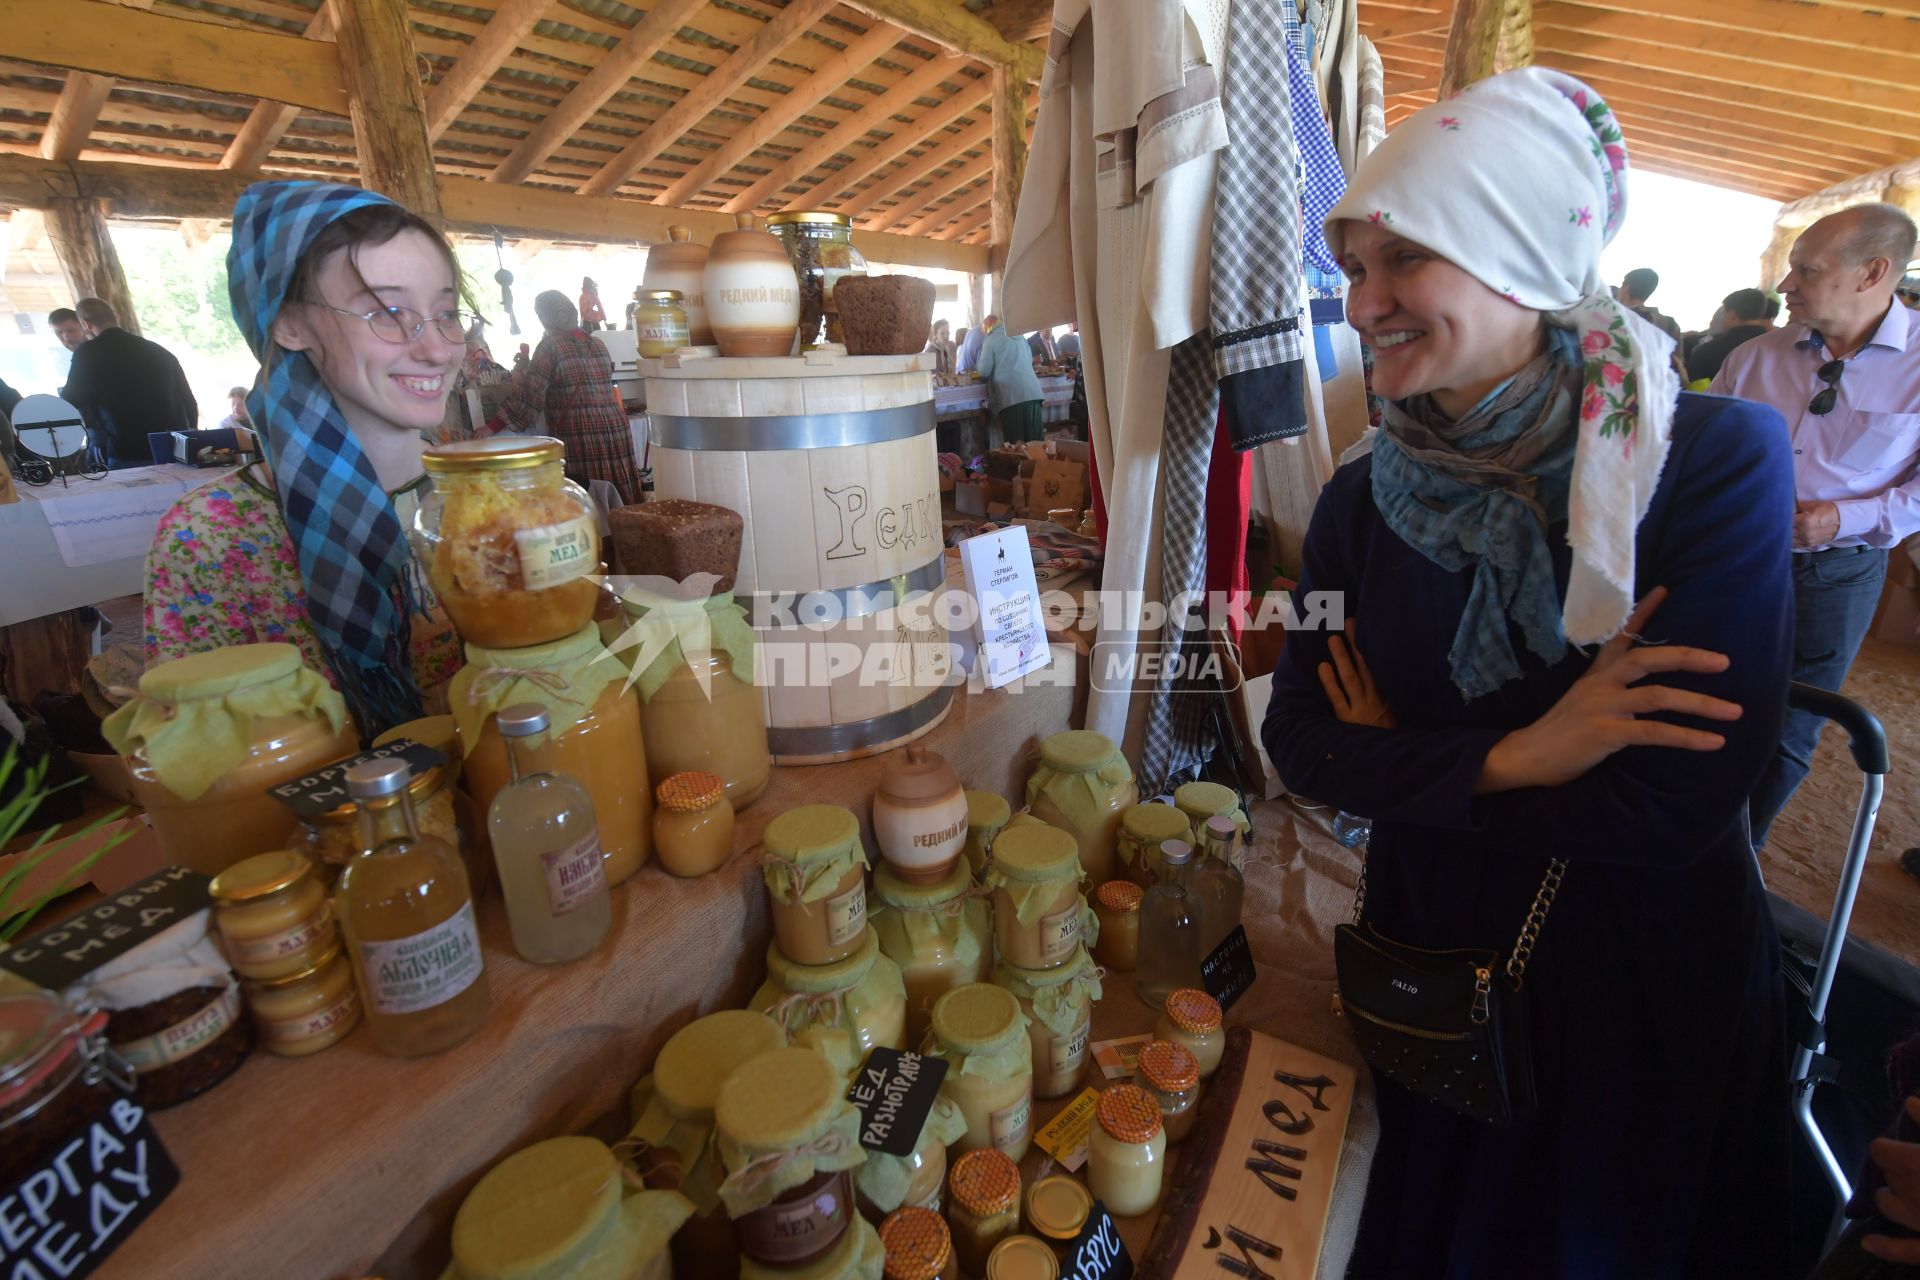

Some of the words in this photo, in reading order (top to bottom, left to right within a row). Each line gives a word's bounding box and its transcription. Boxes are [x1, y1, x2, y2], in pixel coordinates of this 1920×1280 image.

[720, 286, 767, 305] РЕДКИЙ
[994, 565, 1013, 577] ГЕРМАН
[989, 593, 1031, 616] ИНСТРУКЦИЯ
[912, 823, 957, 848] РЕДКИЙ
[11, 865, 192, 963] СОТОВЫЙ
[1391, 979, 1418, 994] PALIO
[0, 1122, 126, 1263] ЕРГА
